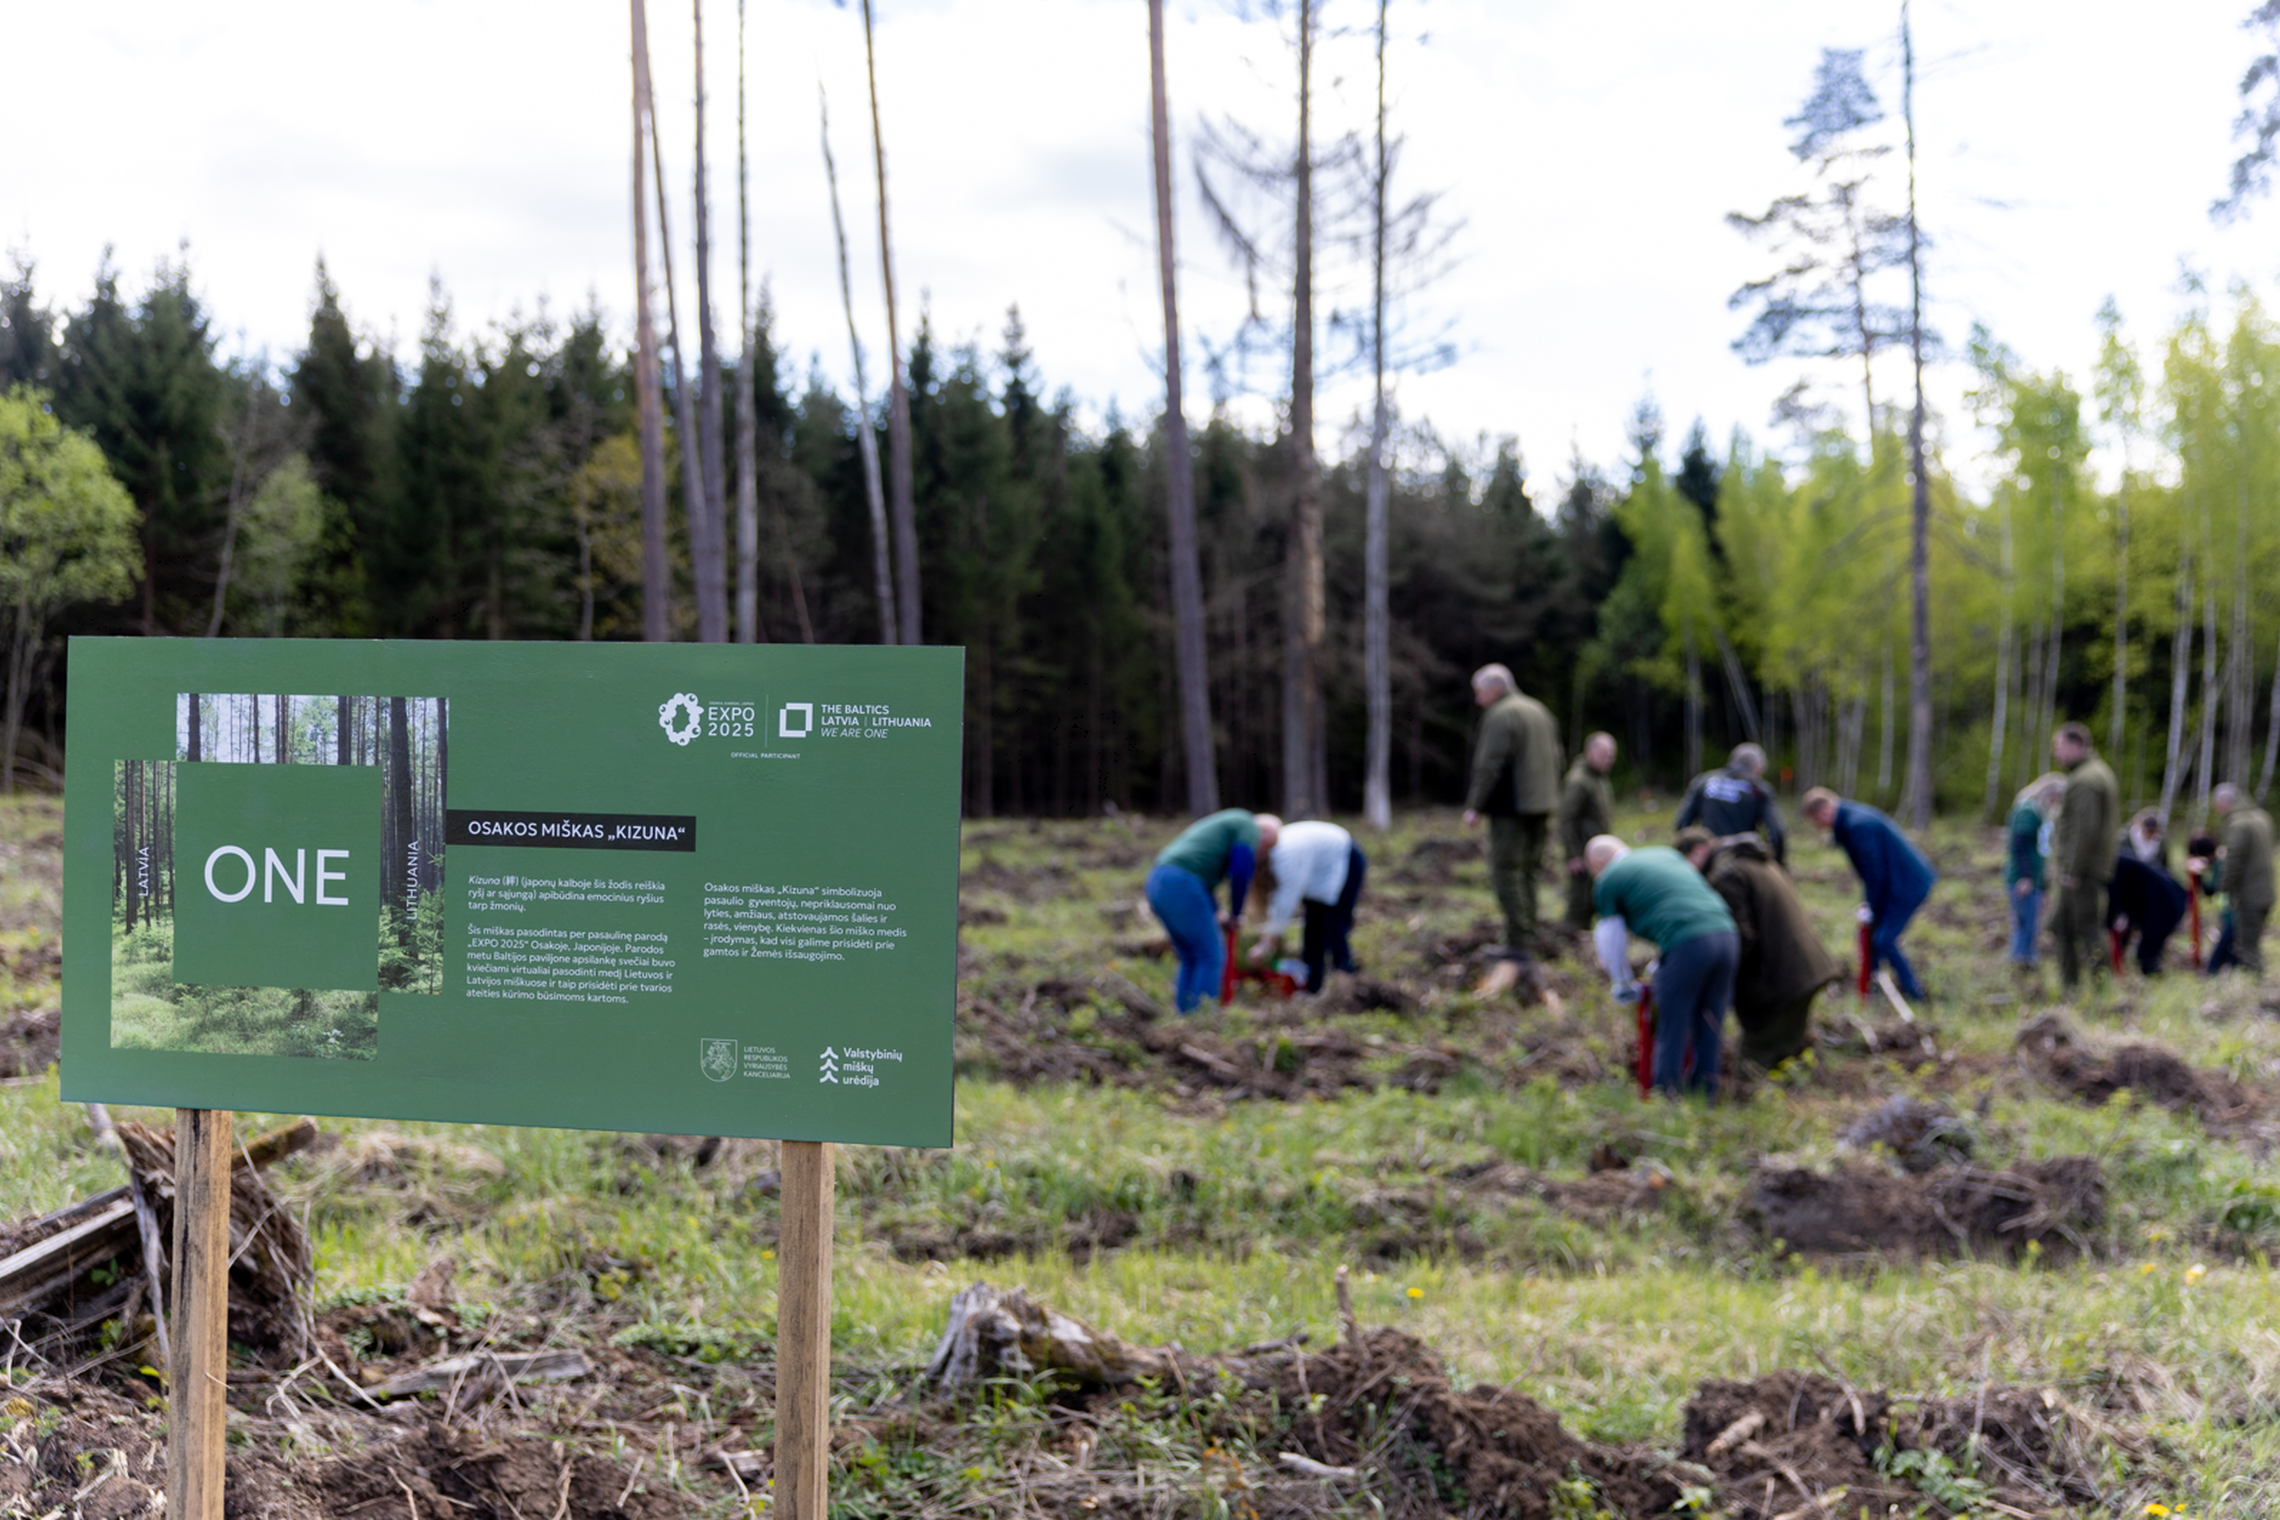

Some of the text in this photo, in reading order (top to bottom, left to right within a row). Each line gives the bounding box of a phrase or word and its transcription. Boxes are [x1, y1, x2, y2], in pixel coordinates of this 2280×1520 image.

[708, 707, 755, 722] EXPO
[821, 704, 889, 715] THE BALTICS
[821, 716, 932, 727] LATVIA LITHUANIA
[708, 723, 754, 736] 2025
[821, 728, 888, 738] WE ARE ONE
[468, 820, 686, 842] OSAKOS MIŠKAS „KIZUNA“
[138, 846, 150, 897] LATVIA
[204, 845, 350, 906] ONE
[406, 840, 419, 920] LITHUANIA
[468, 875, 500, 885] Kizuna
[521, 876, 556, 889] (japonų
[558, 878, 592, 889] kalboje
[594, 878, 606, 889] šis
[608, 879, 633, 889] žodis
[635, 880, 665, 891] reiškia
[468, 888, 484, 900] ryšį
[498, 889, 537, 900] sąjungą)
[538, 890, 585, 901] apibūdina
[587, 892, 634, 902] emocinius
[636, 894, 664, 905] ryšius
[704, 882, 882, 898] Osakos miškas „Kizuna“ simbolizuoja
[468, 901, 526, 913] tarp žmonių.
[704, 896, 896, 911] pasaulio gyventojų, nepriklausomai nuo
[704, 908, 888, 923] lyties, amžiaus, atstovaujamos šalies ir
[468, 924, 668, 943] Šis miškas pasodintas per pasaulinę parodą
[704, 922, 907, 937] rasės, vienybę. Kiekvienas šio miško medis
[467, 938, 664, 954] „EXPO 2025“ Osakoje, Japonijoje. Parodos
[710, 935, 758, 946] įrodymas,
[760, 936, 778, 945] kad
[780, 937, 796, 946] visi
[798, 938, 830, 949] galime
[832, 939, 873, 950] prisidėti
[875, 941, 895, 950] prie
[467, 951, 676, 968] metu Baltijos paviljone apsilankę svečiai buvo
[703, 946, 845, 961] gamtos ir Žemės išsaugojimo.
[467, 963, 673, 980] kviečiami virtualiai pasodinti medį Lietuvos ir
[467, 976, 672, 993] Latvijos miškuose ir taip prisidėti prie tvarios
[466, 988, 629, 1003] ateities kūrimo būsimoms kartoms.
[844, 1047, 903, 1062] Valstybinių
[743, 1062, 788, 1071] VYRIAUSYBĖS
[843, 1060, 874, 1073] miškų
[743, 1071, 790, 1079] KANCELIARIJA
[843, 1074, 879, 1088] urėdija
